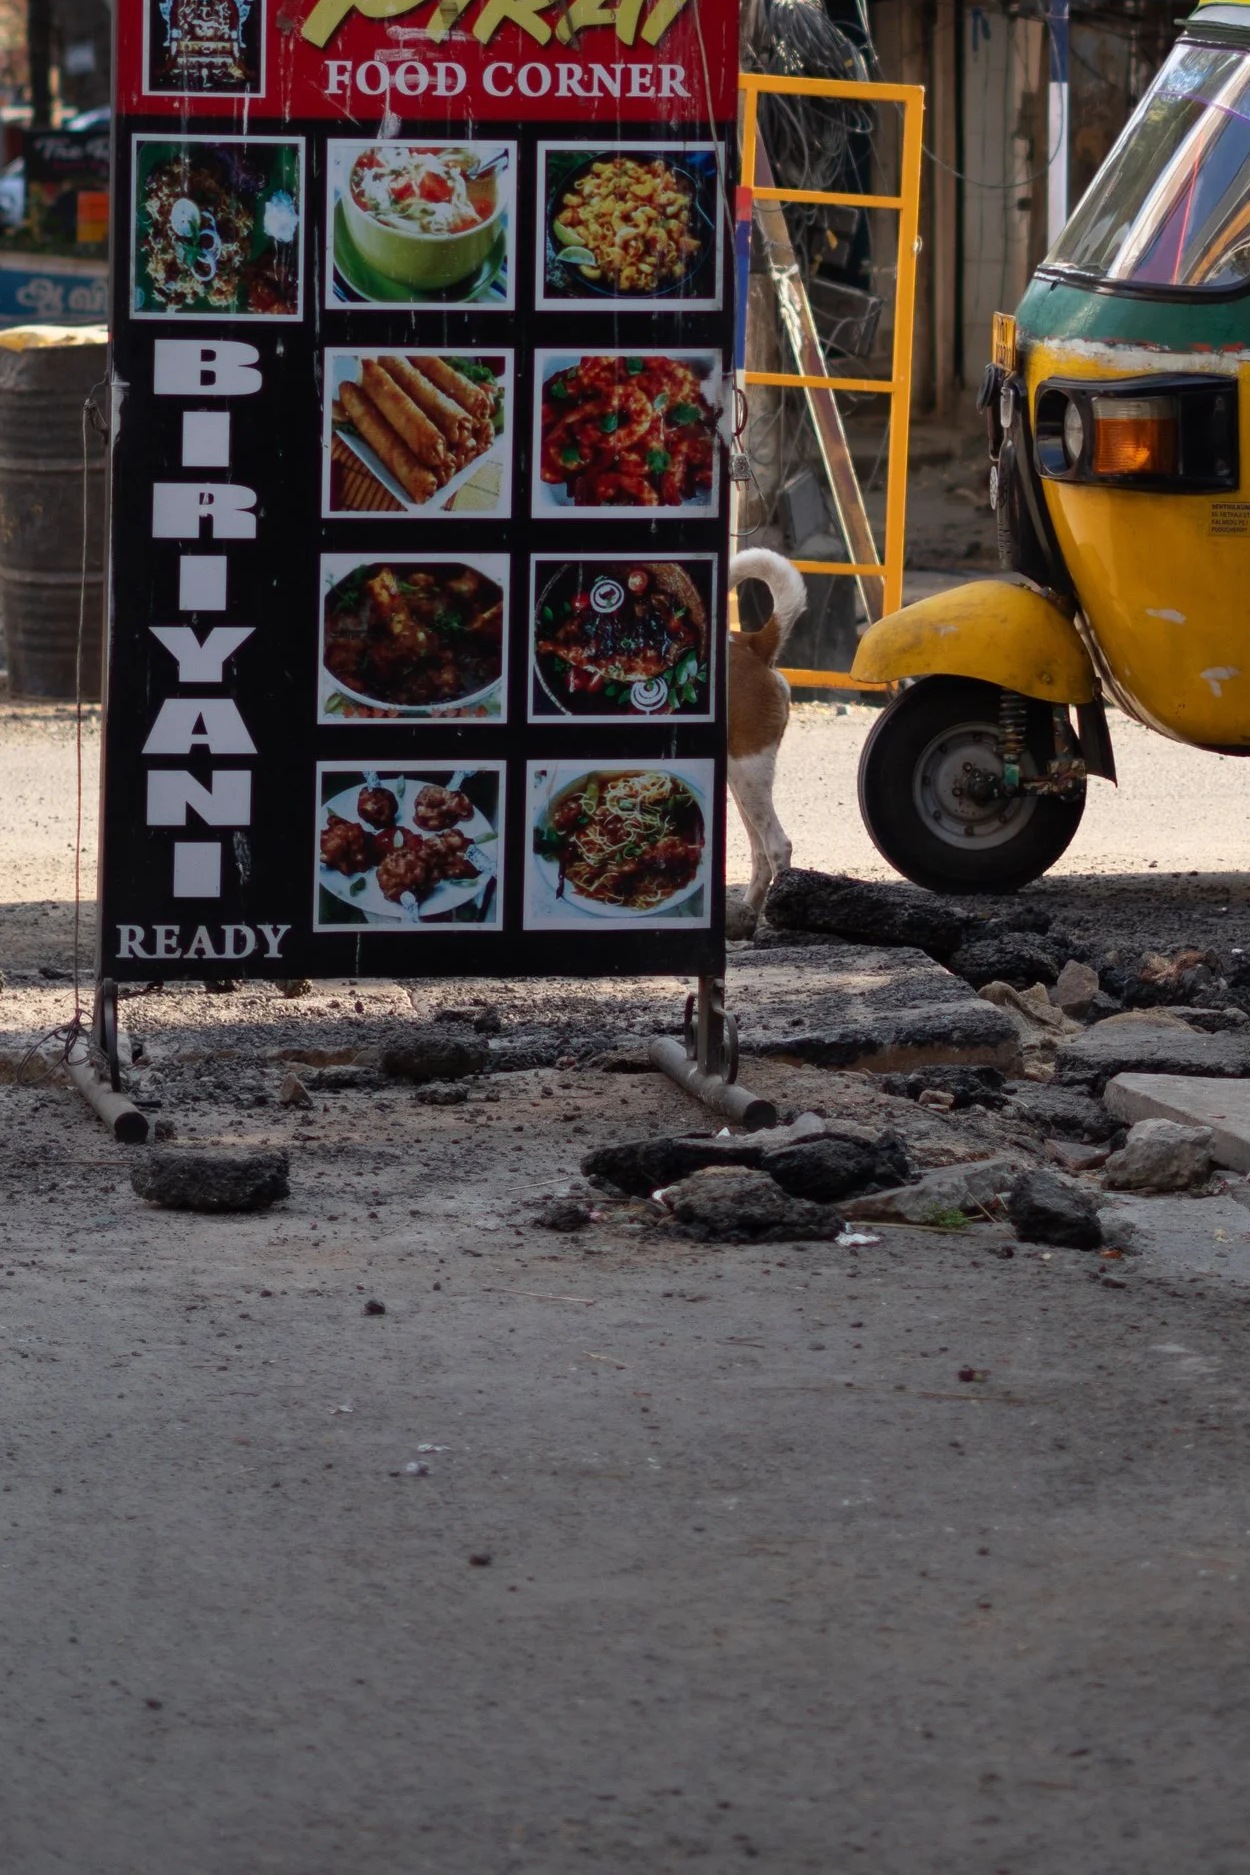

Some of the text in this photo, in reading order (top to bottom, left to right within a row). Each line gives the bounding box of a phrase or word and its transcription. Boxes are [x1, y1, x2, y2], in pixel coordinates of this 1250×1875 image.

[325, 60, 691, 98] FOOD CORNER
[141, 338, 263, 899] BIRIYANI
[115, 924, 291, 960] READY
